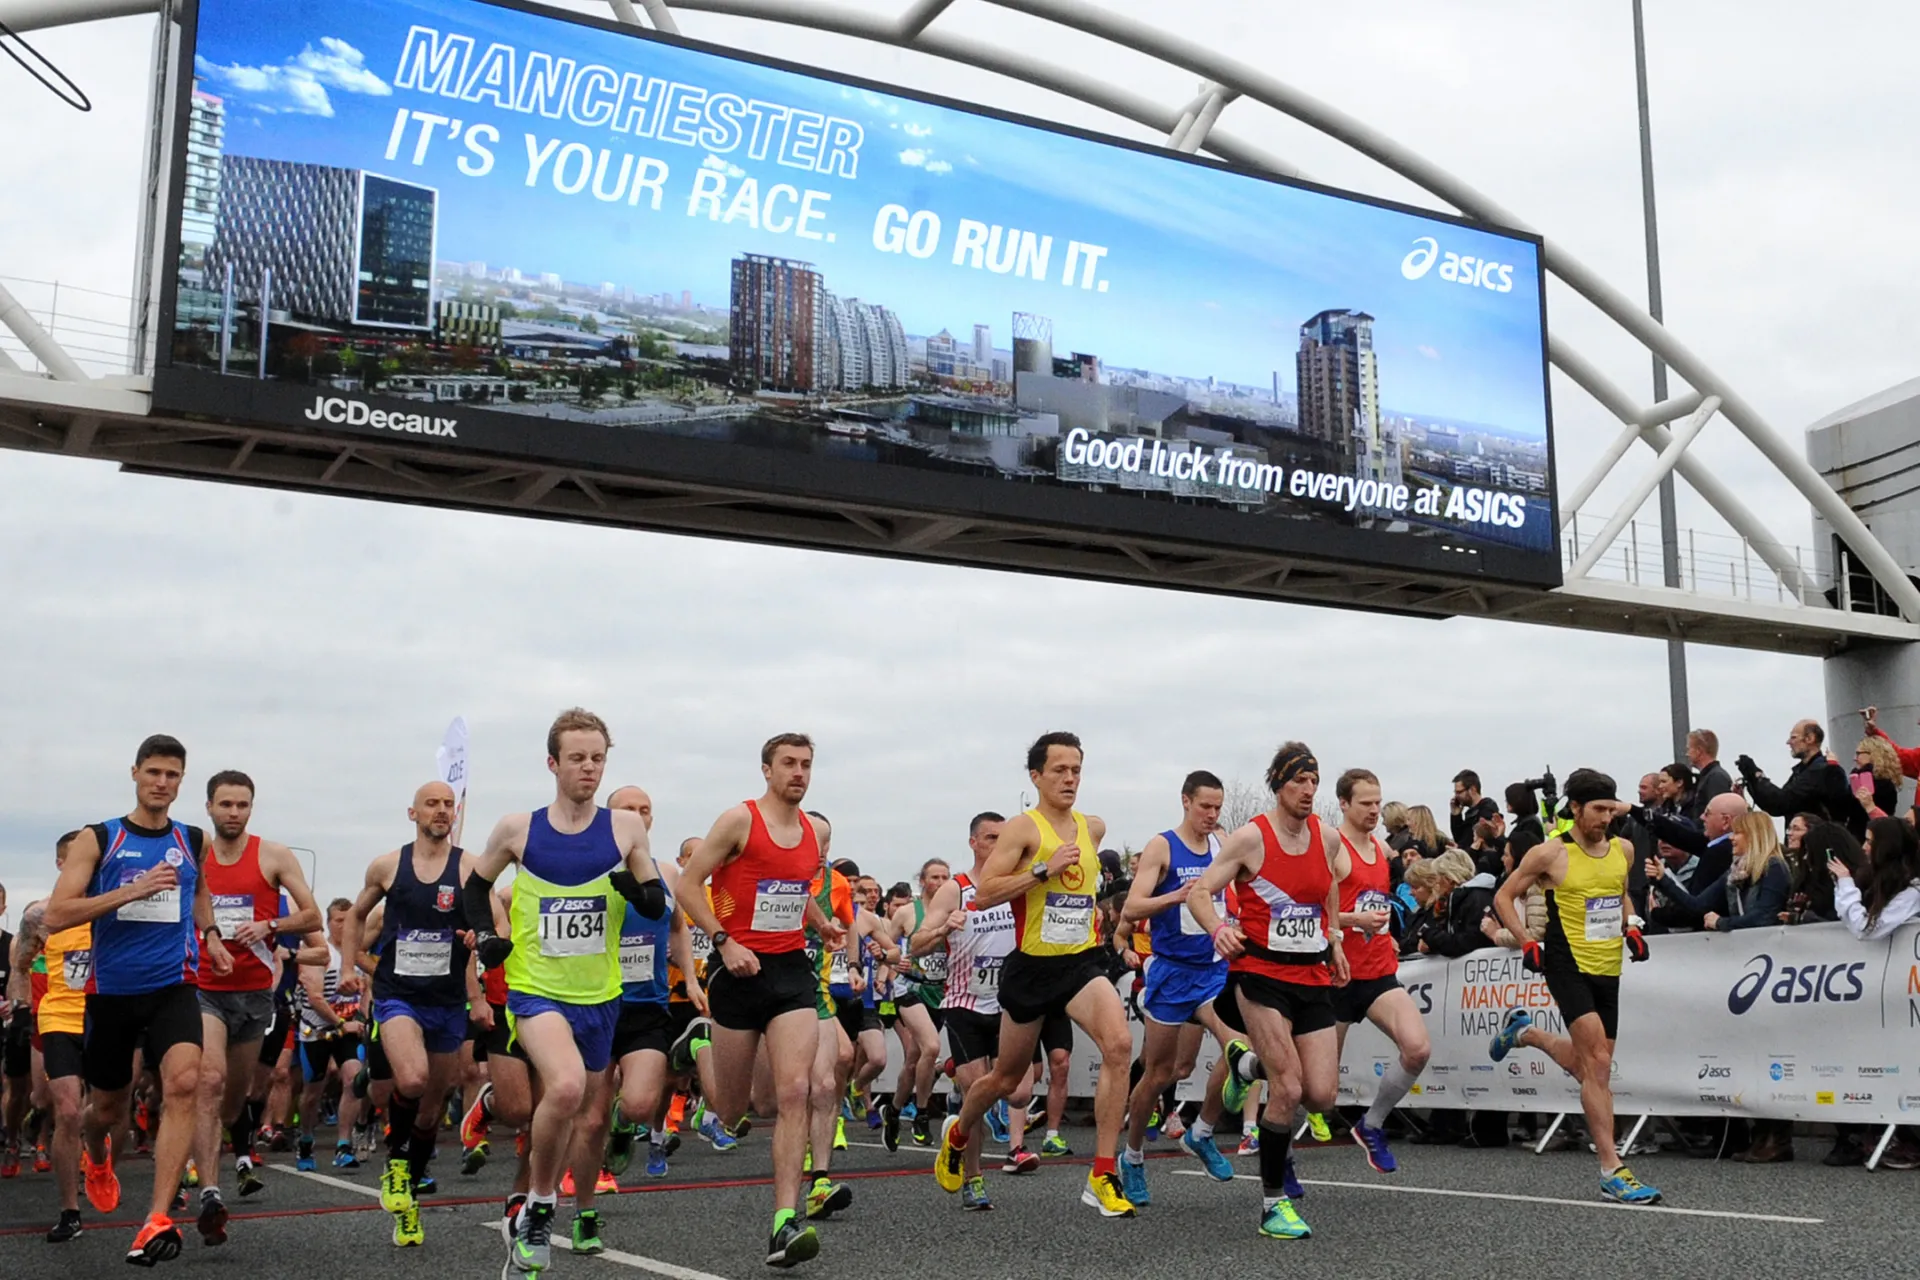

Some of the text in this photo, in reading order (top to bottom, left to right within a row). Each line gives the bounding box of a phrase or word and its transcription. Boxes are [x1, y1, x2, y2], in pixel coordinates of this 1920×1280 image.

[394, 26, 864, 179] MANCHESTER
[384, 107, 1109, 292] IT'S YOUR RACE. GO RUN IT.
[304, 396, 457, 438] JCDecaux
[1064, 427, 1527, 529] Good luck from everyone at ASICS
[779, 884, 802, 892] asics
[564, 900, 594, 910] asics
[1292, 907, 1313, 915] asics
[543, 913, 604, 939] 11634
[972, 911, 1013, 925] BARLIC
[1276, 919, 1315, 938] 6340
[70, 962, 89, 979] 77
[978, 969, 1000, 985] 91
[1771, 962, 1866, 1004] asics
[1461, 983, 1559, 1009] MANCHES
[1460, 1010, 1561, 1036] MARON
[1708, 1067, 1731, 1078] asics
[1843, 1093, 1872, 1101] POLAR
